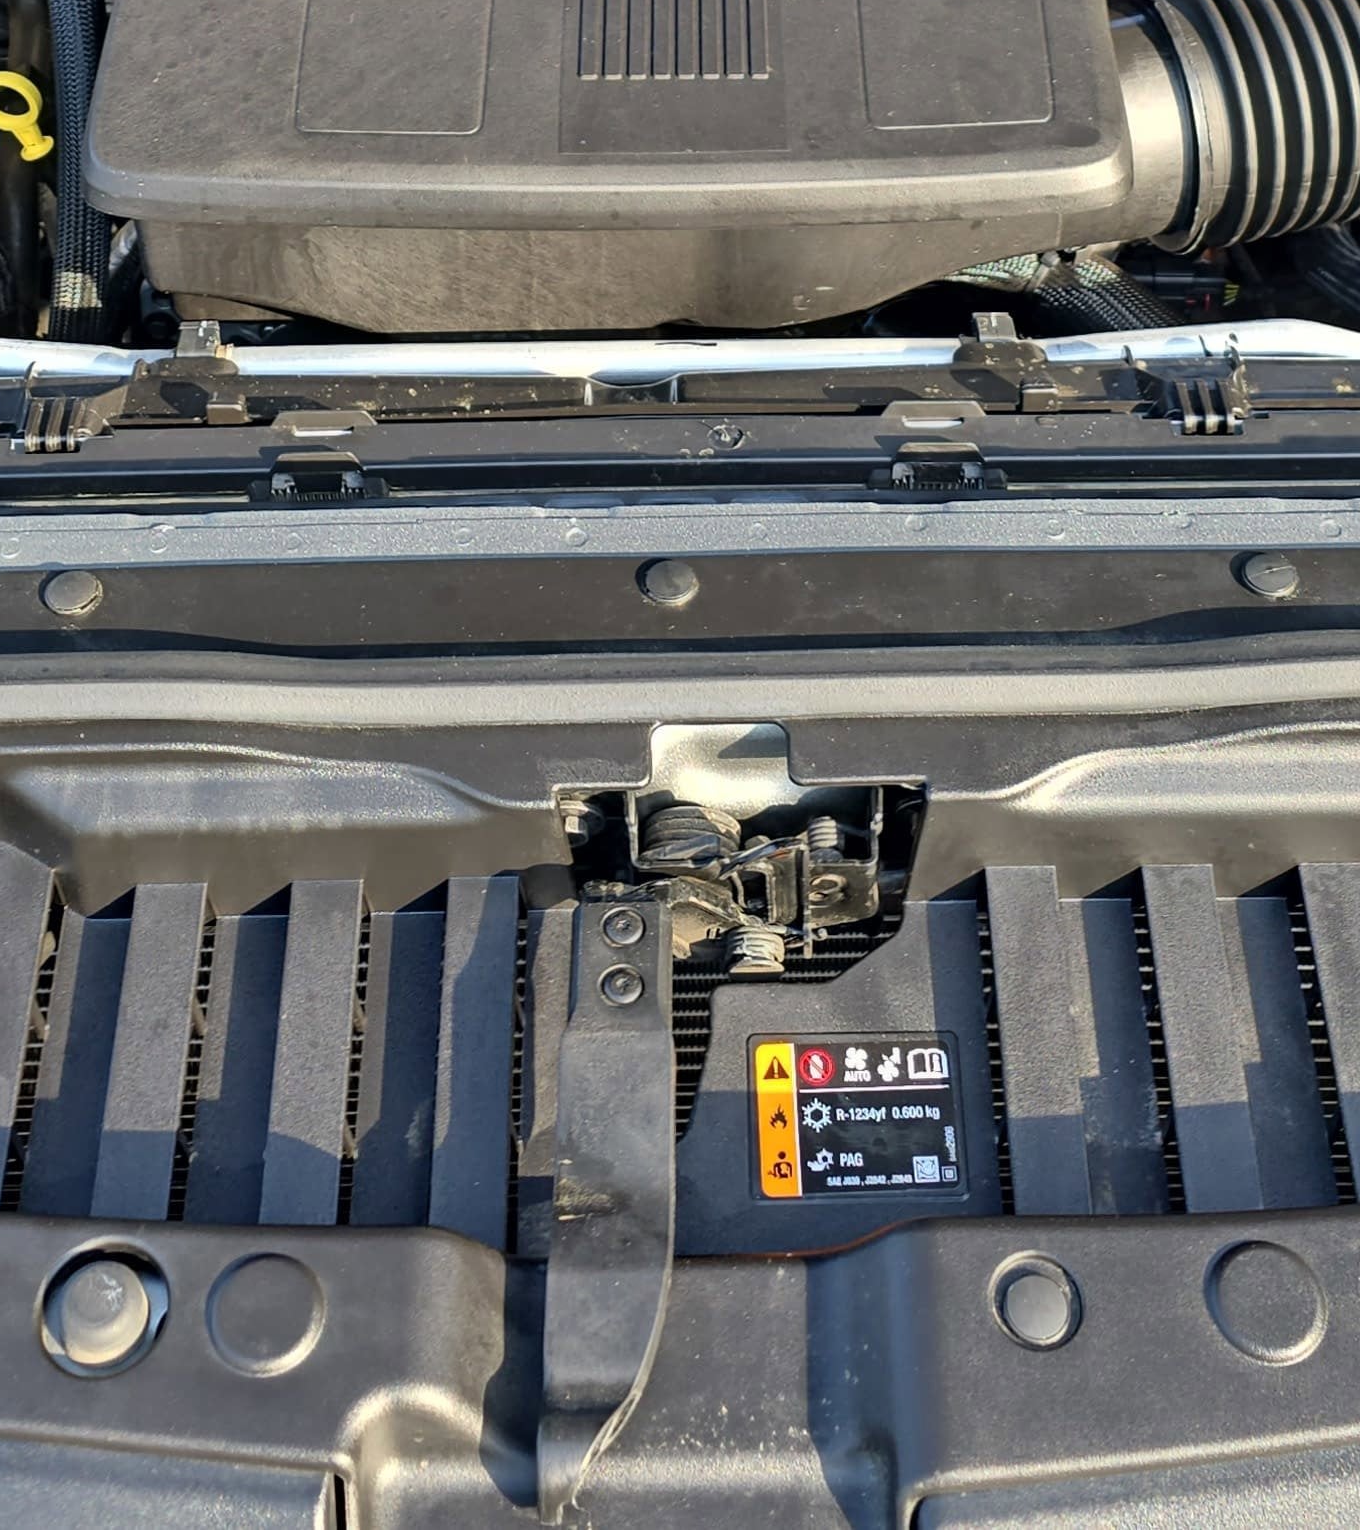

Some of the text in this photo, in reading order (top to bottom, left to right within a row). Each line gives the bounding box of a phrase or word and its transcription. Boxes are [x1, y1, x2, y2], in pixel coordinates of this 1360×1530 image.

[844, 1070, 871, 1082] AUTO
[836, 1103, 940, 1122] R-1234yf 0.600 kg
[839, 1152, 864, 1167] PAG
